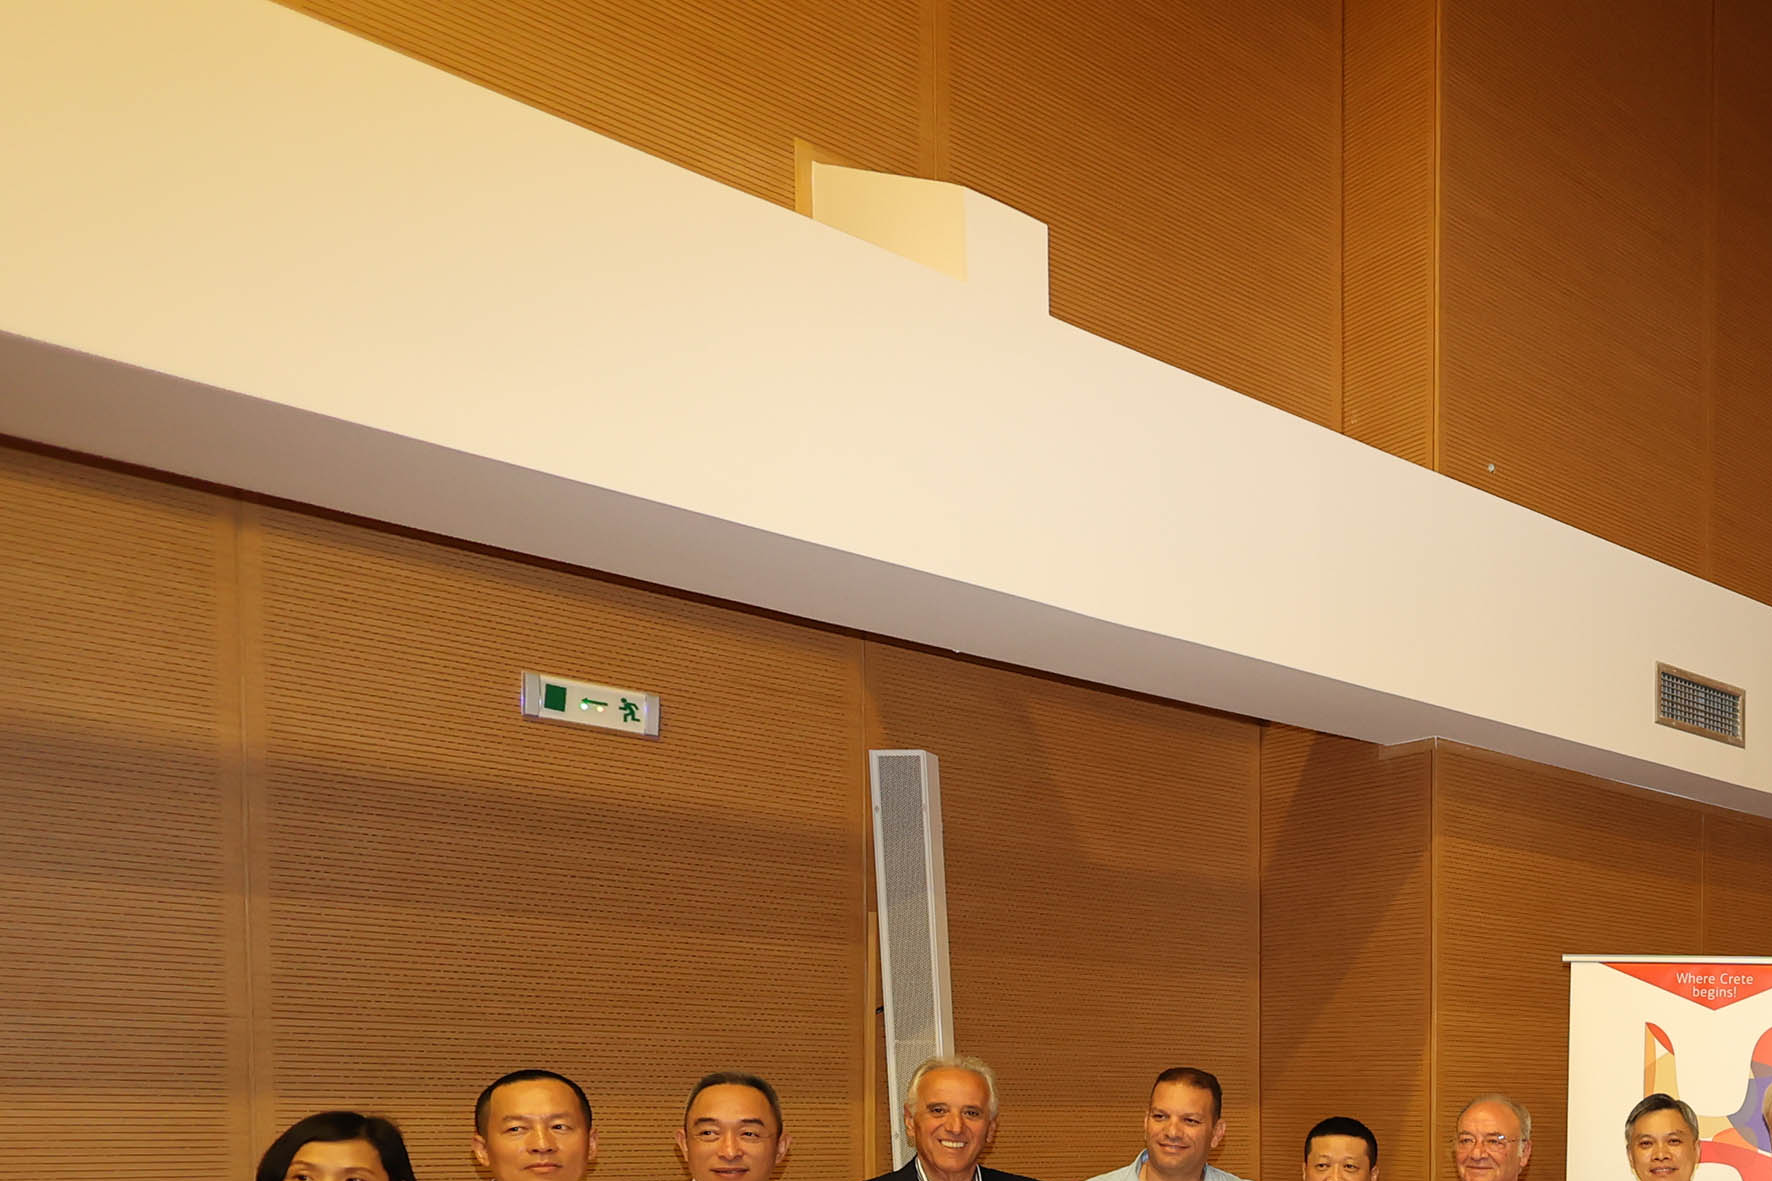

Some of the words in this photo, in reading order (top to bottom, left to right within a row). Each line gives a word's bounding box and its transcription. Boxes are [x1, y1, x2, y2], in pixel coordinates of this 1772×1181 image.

[1676, 972, 1716, 984] Where
[1720, 973, 1754, 985] Crete
[1692, 986, 1737, 1001] begins!
